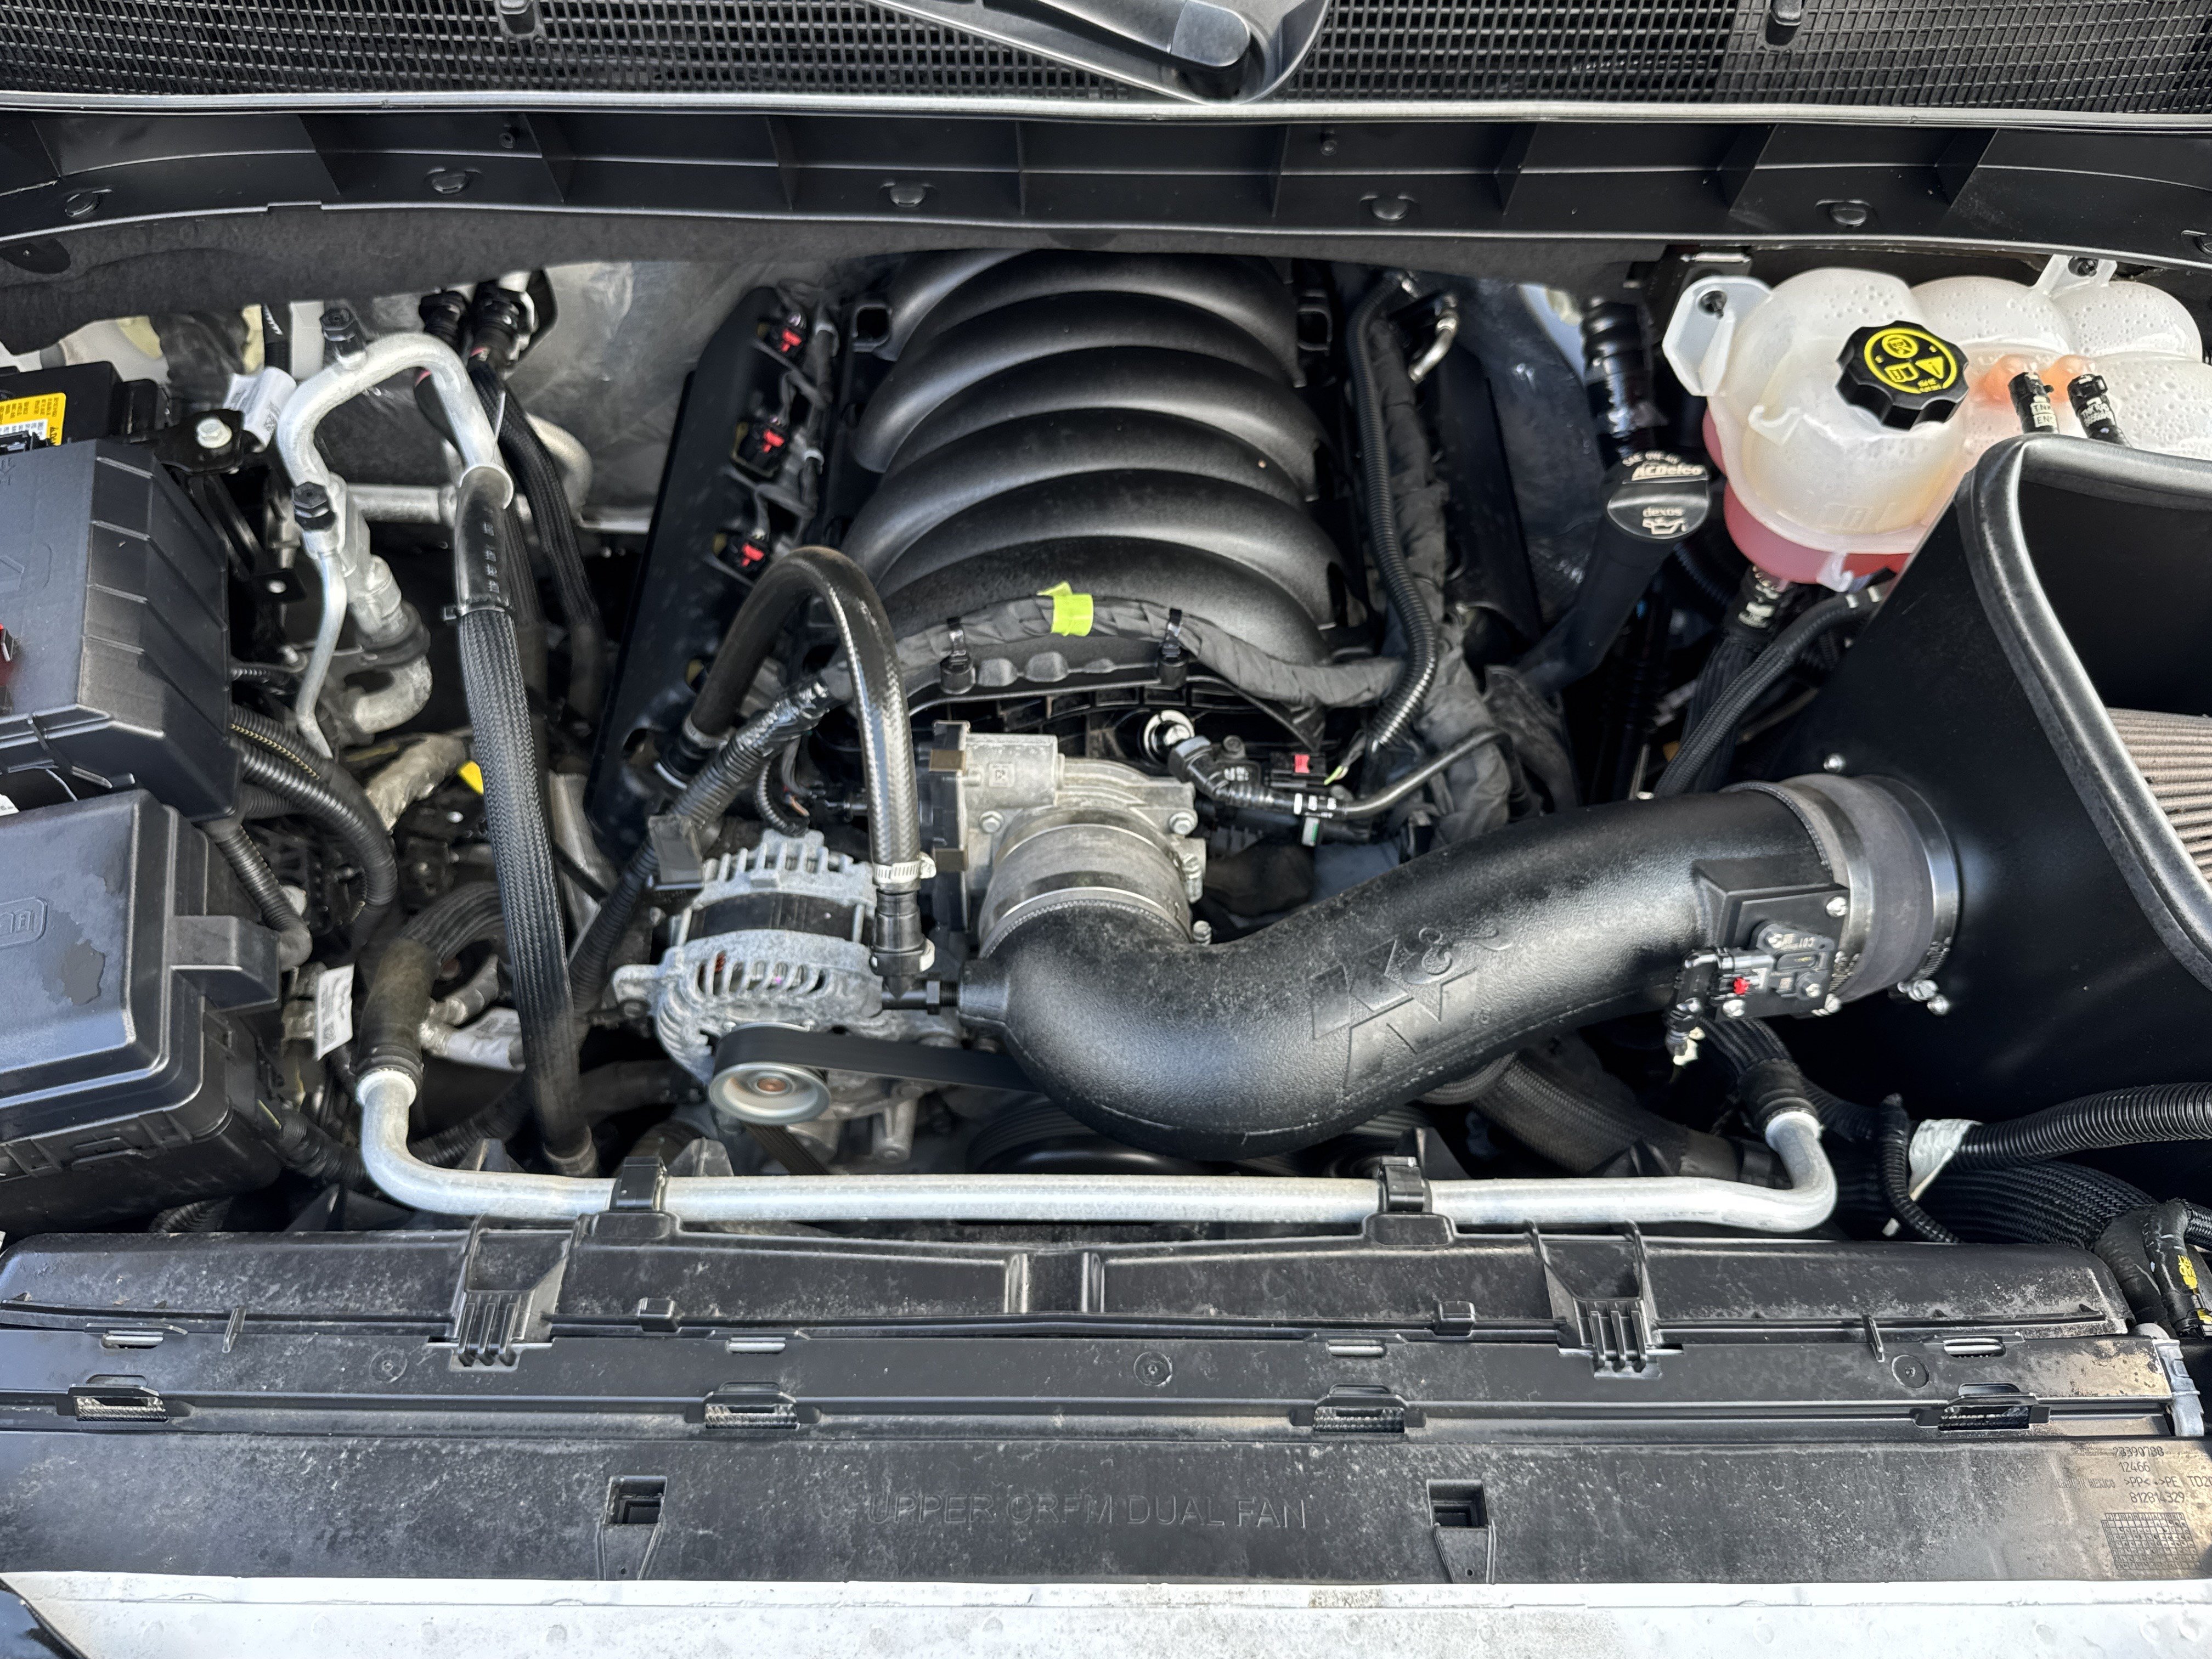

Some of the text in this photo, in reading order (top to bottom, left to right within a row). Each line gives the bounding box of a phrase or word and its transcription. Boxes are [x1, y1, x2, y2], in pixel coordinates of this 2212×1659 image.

[1632, 464, 1705, 481] ACDelco
[1643, 507, 1684, 517] dexos
[2119, 1462, 2151, 1472] 12466
[2088, 1478, 2115, 1488] MEXICO
[2129, 1491, 2185, 1504] 812814329
[867, 1493, 995, 1524] UPPER
[1127, 1495, 1225, 1526] DUAL
[1235, 1498, 1307, 1529] FAN
